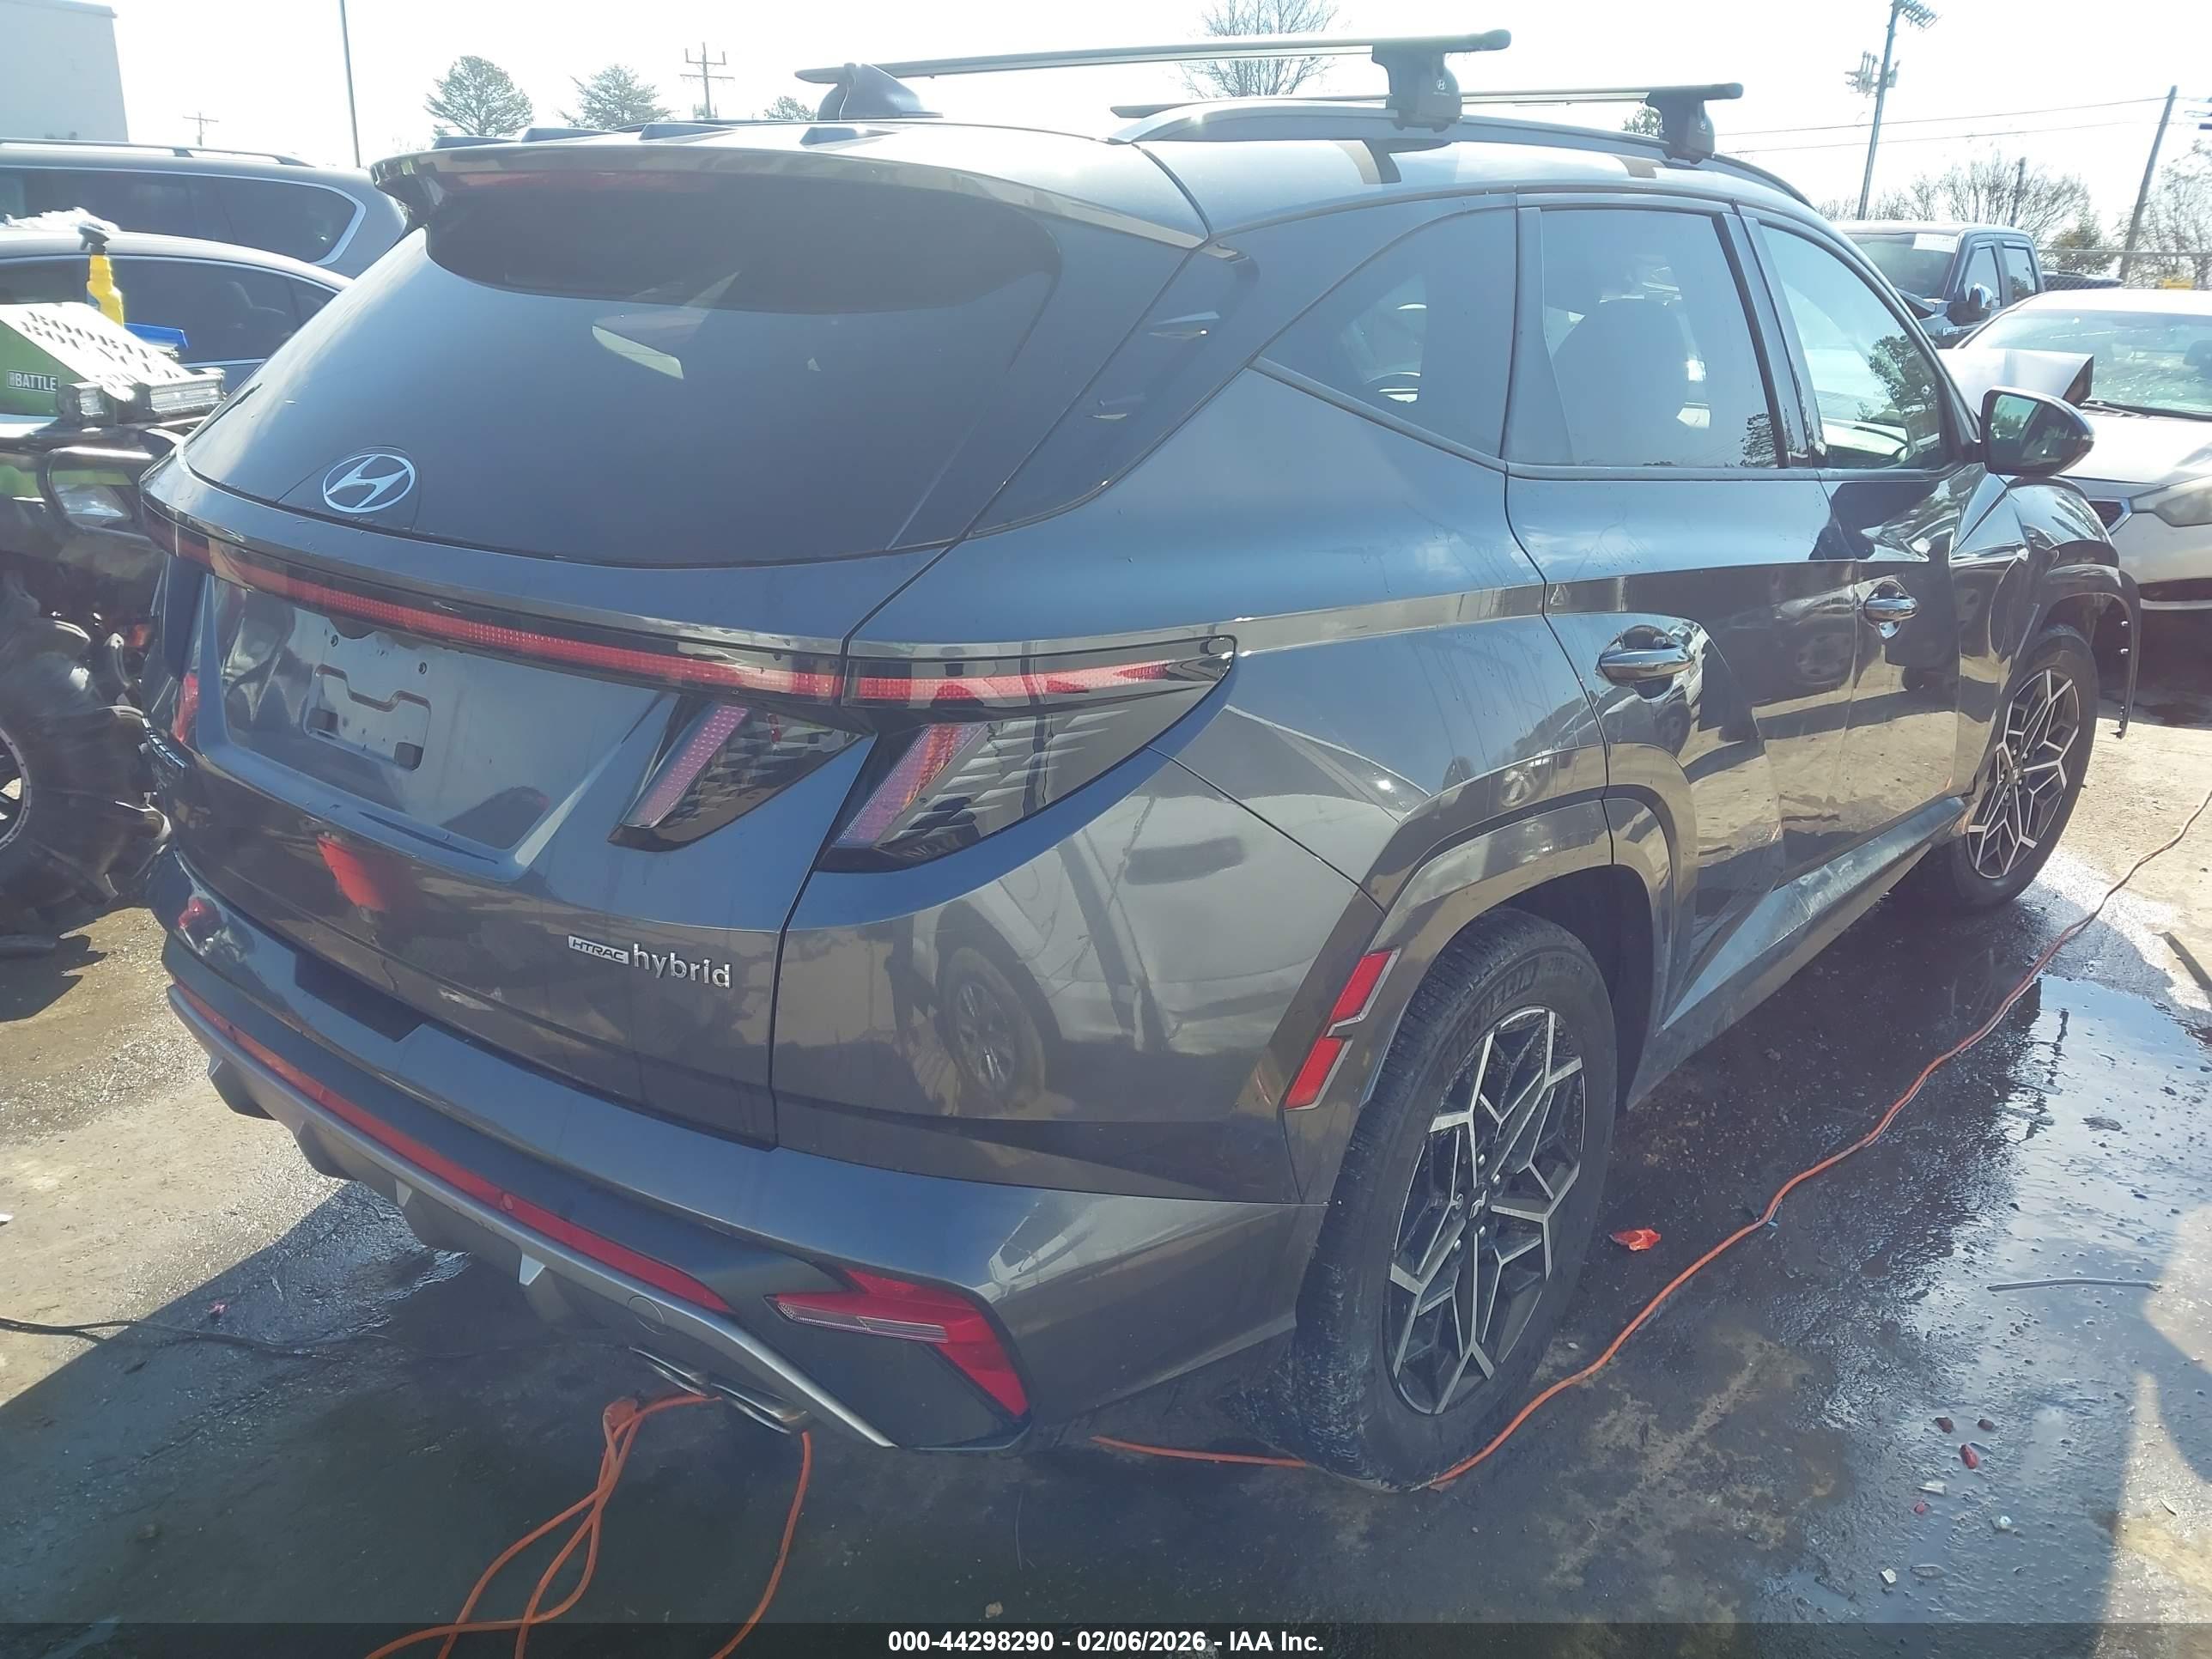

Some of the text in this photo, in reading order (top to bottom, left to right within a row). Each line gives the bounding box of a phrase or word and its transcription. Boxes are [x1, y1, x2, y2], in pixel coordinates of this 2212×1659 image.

[15, 373, 57, 392] BATTLE
[571, 938, 731, 988] HTRAC hybrid
